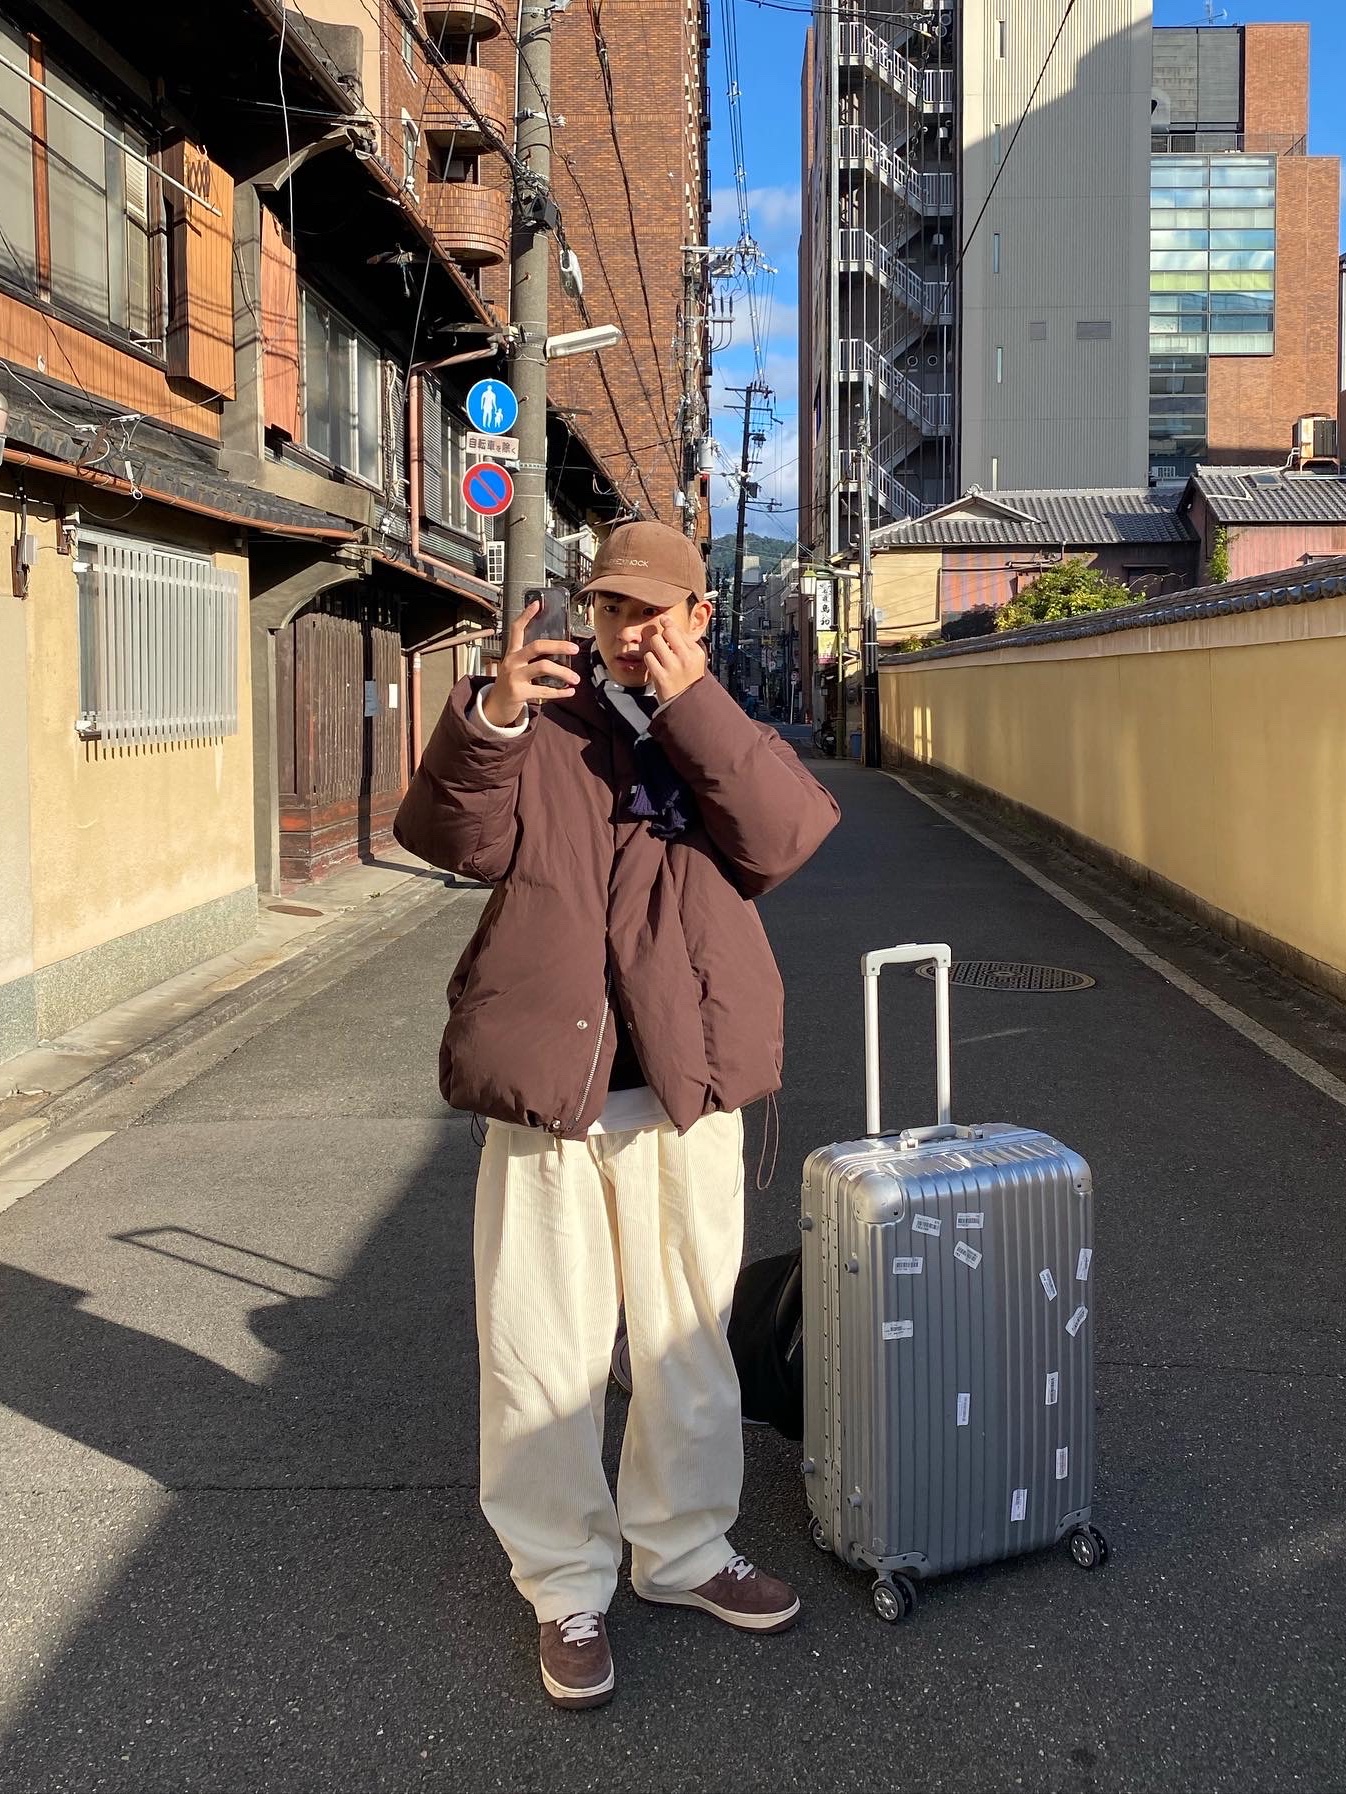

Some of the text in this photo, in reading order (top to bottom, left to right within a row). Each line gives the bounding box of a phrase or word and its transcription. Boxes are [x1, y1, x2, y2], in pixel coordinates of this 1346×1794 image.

[469, 437, 516, 455] 自転車を除く
